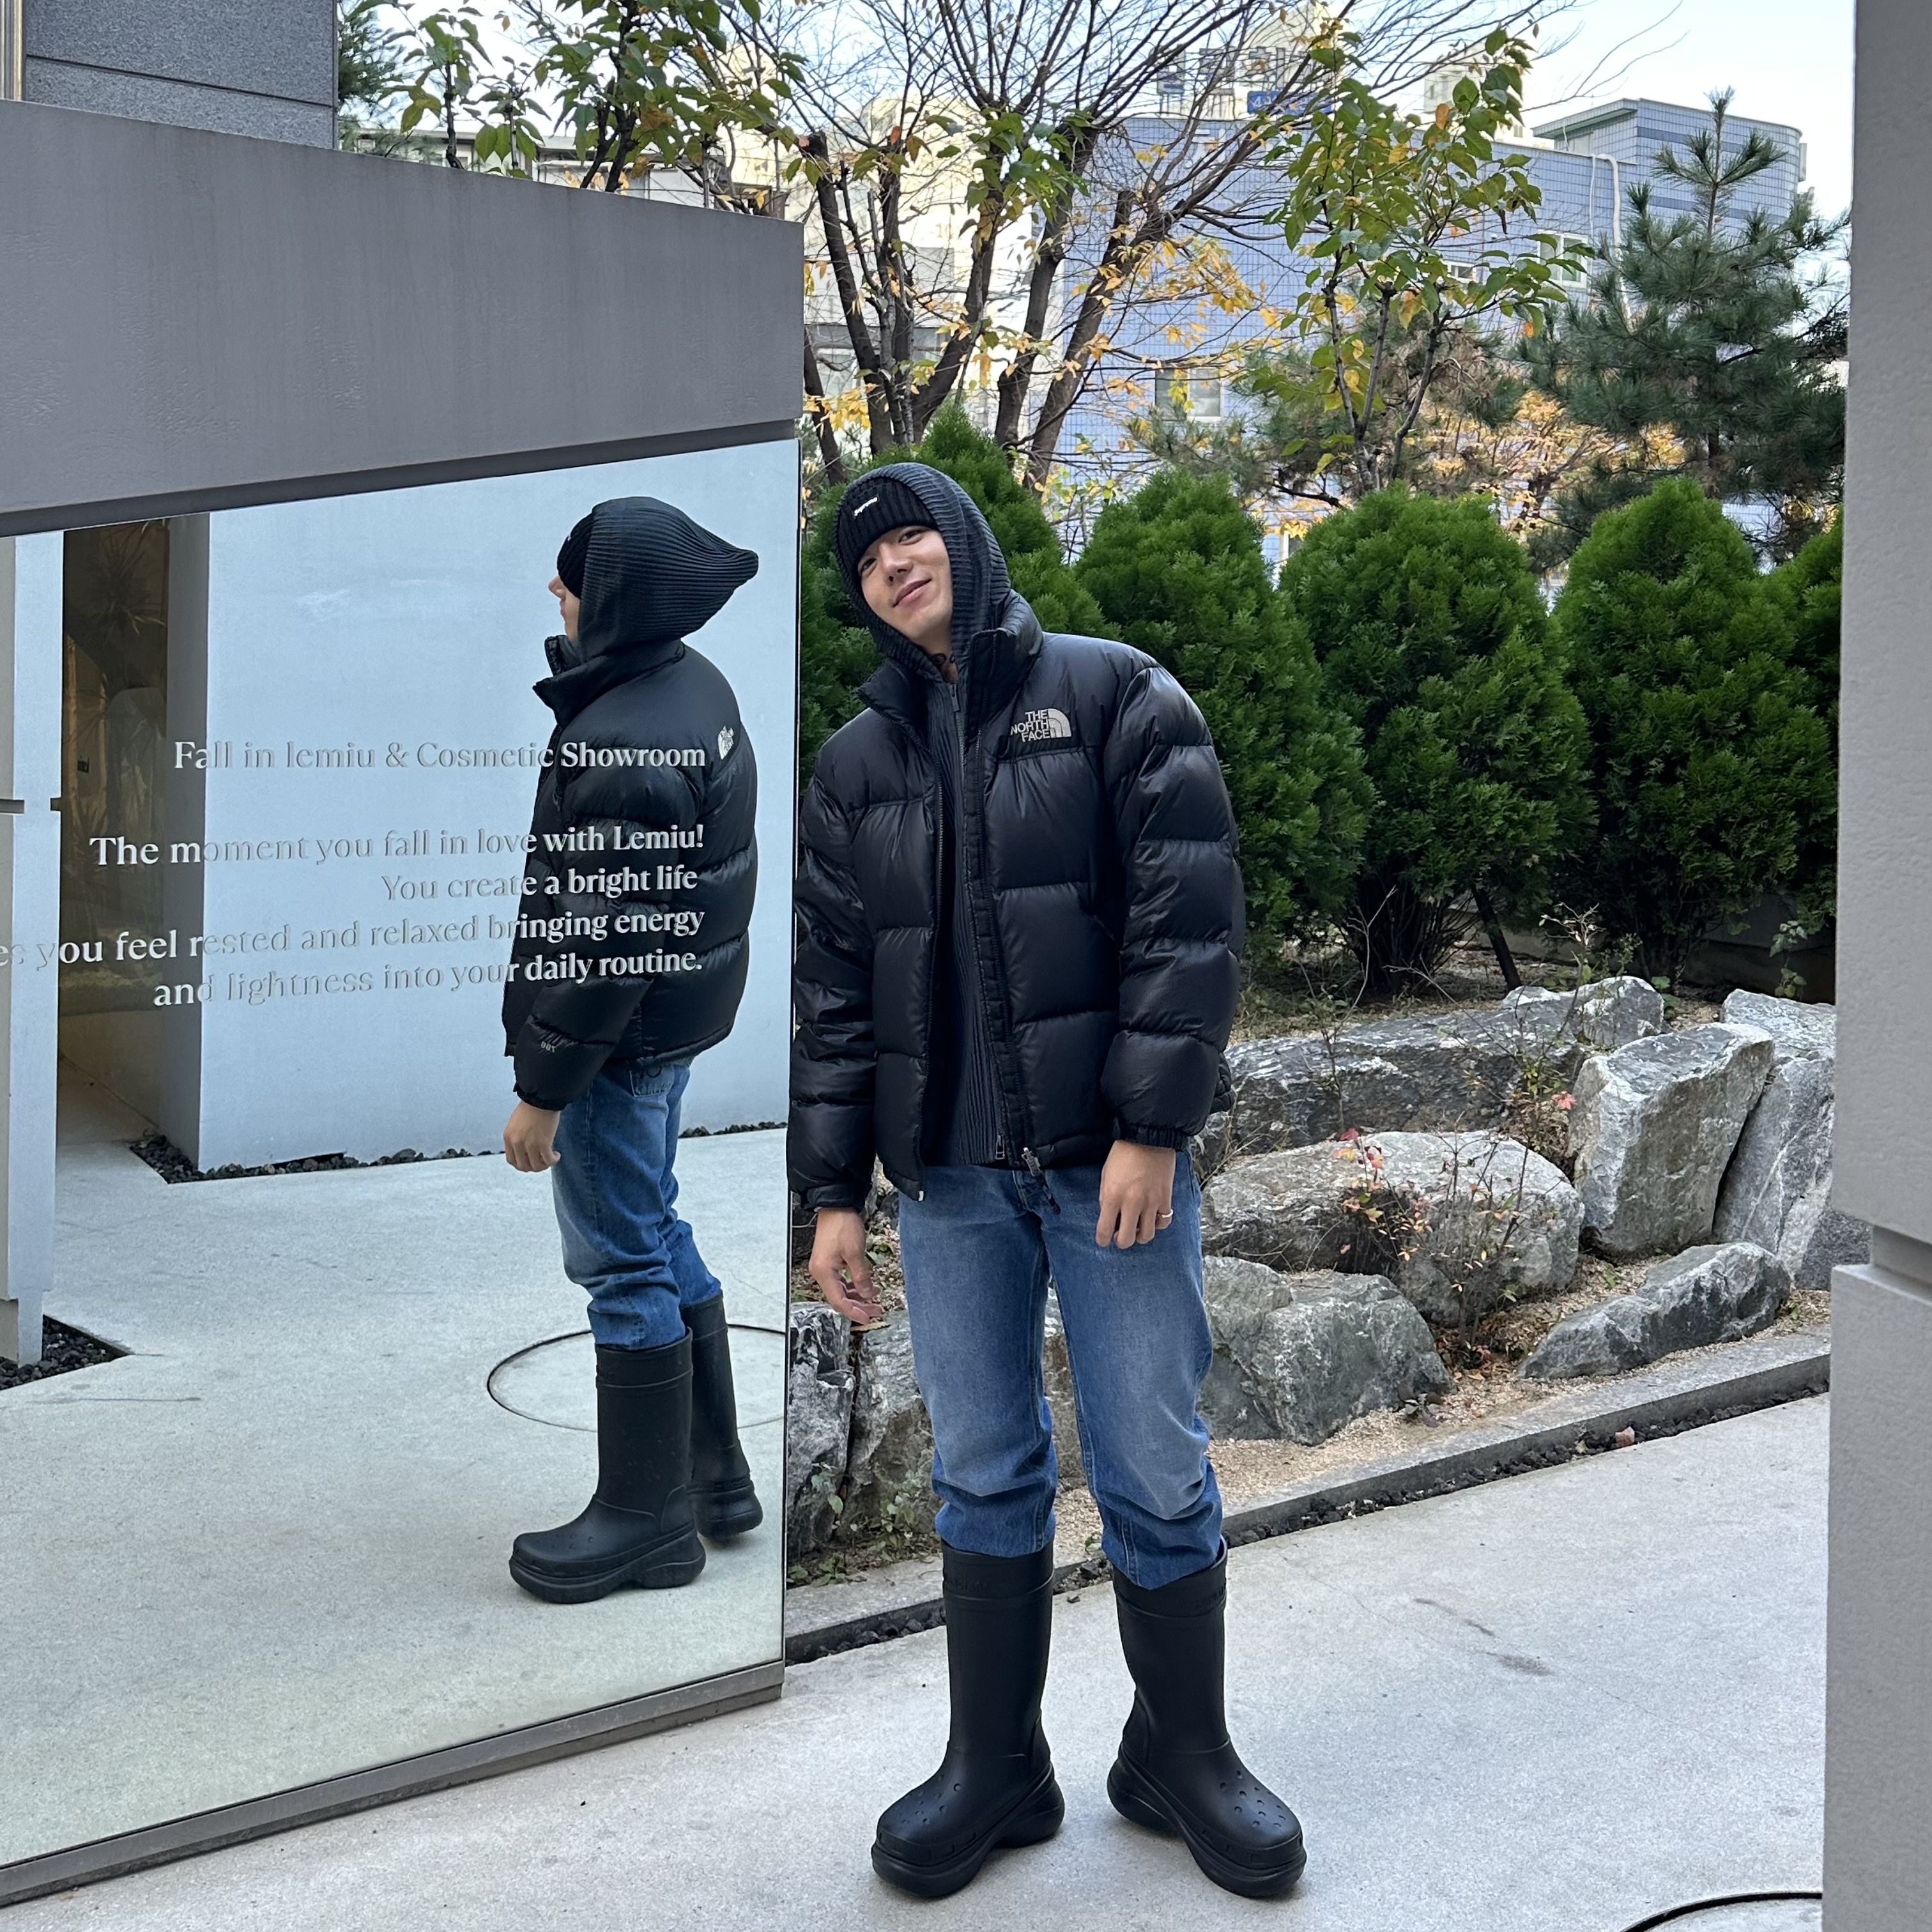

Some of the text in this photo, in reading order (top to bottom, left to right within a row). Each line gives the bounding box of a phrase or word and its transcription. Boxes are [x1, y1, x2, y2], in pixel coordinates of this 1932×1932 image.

[1010, 718, 1049, 735] NORTH
[1025, 709, 1048, 723] THE
[1022, 729, 1051, 742] FACE
[174, 741, 233, 769] Fall
[245, 742, 275, 768] in
[385, 742, 409, 767] &
[417, 742, 554, 767] Cosmetic
[560, 742, 706, 767] Showroom
[89, 824, 704, 865] The moment you fall in love with Lemiu!
[381, 864, 698, 900] You create a bright life
[36, 940, 103, 971] you
[116, 930, 178, 961] feel
[190, 924, 291, 957] rested
[301, 921, 360, 951] and
[371, 915, 480, 946] relaxed
[489, 912, 608, 943] bringing
[615, 910, 705, 936] energy
[153, 949, 703, 1006] and lightness into your daily routine.
